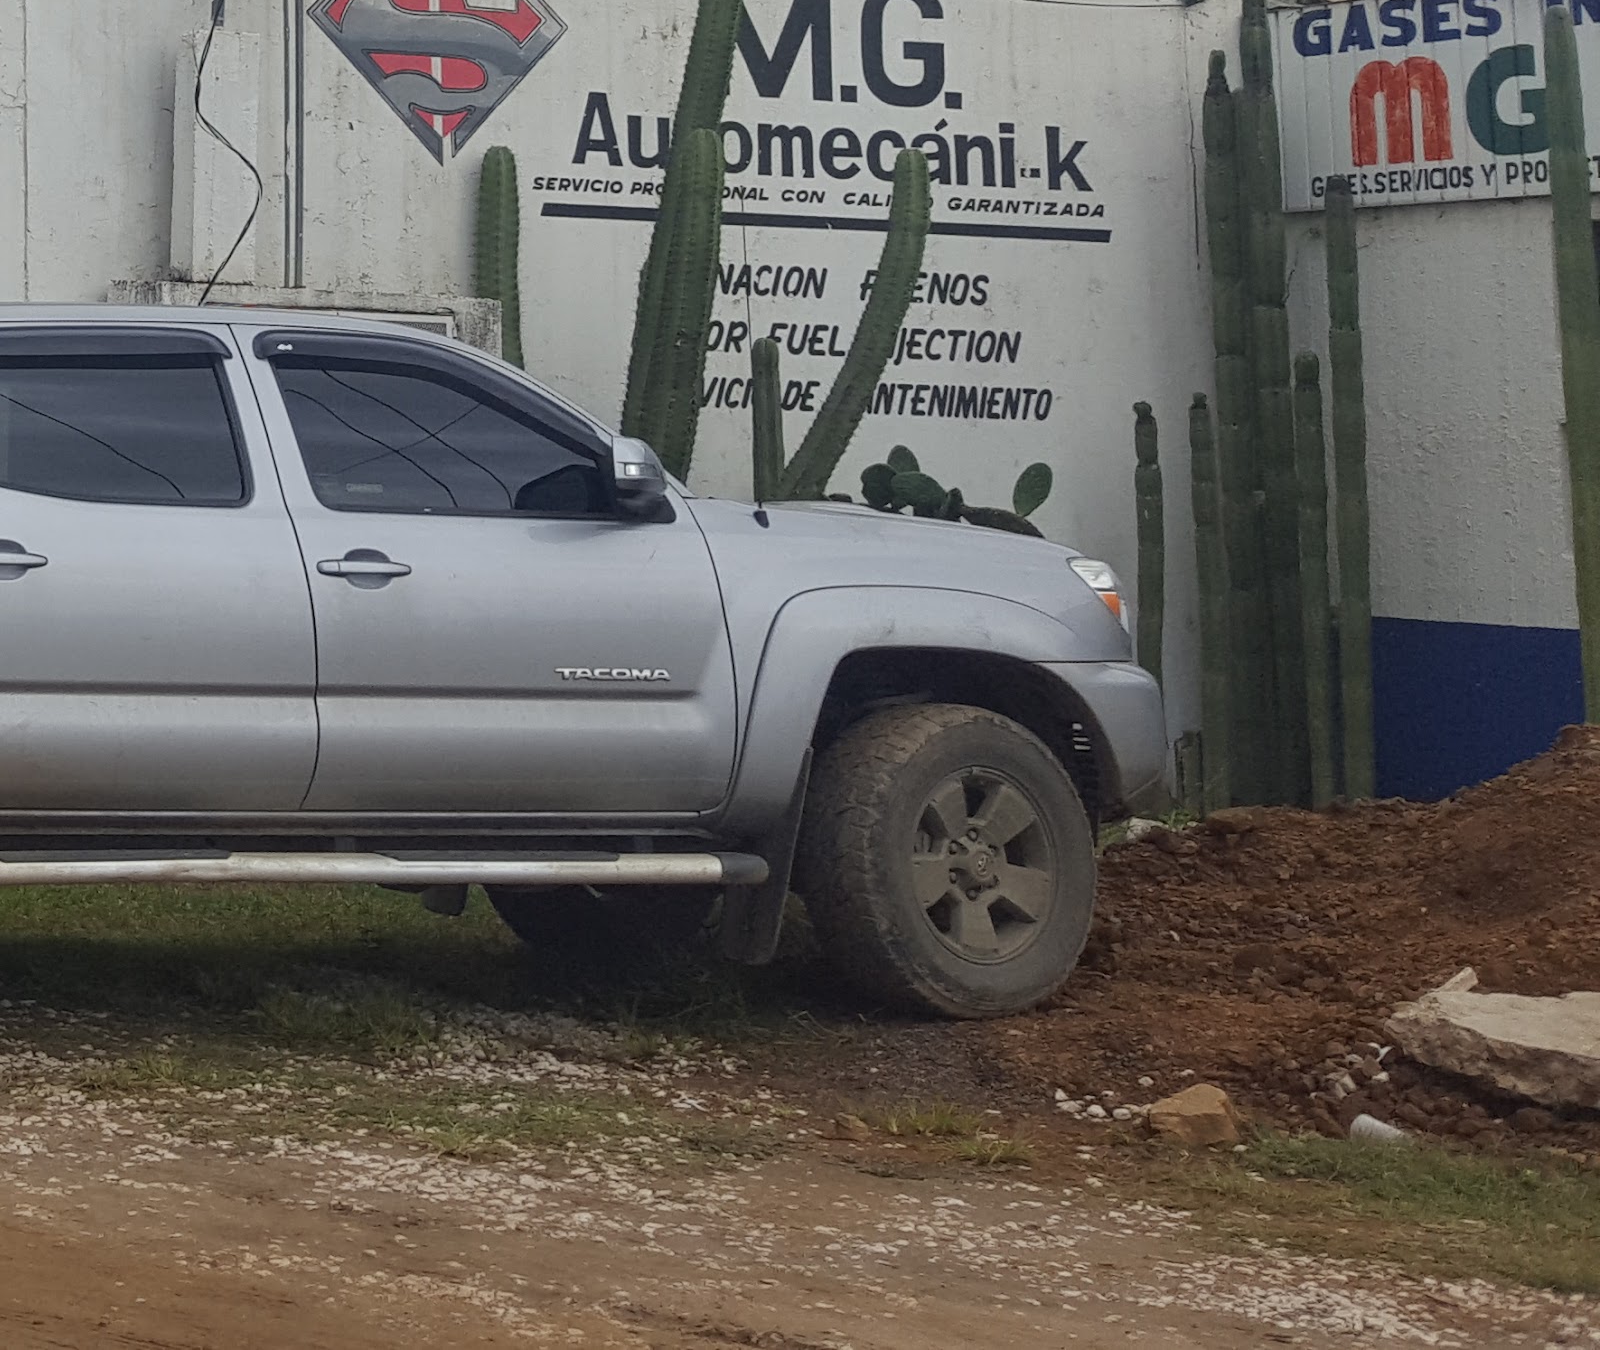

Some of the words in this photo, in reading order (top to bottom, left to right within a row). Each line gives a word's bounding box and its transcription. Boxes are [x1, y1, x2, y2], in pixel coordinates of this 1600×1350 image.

[1480, 163, 1497, 186] Y
[532, 176, 624, 195] SERVICIO
[781, 189, 826, 204] CON
[947, 196, 1105, 218] GARANTIZADA
[719, 264, 828, 299] NACION
[860, 270, 990, 306] FENOS
[767, 323, 846, 357] FUEL
[887, 328, 1022, 366] JECTION
[781, 380, 820, 411] DE
[865, 382, 1053, 421] NTENIMIENTO
[554, 667, 671, 681] TACOMA
